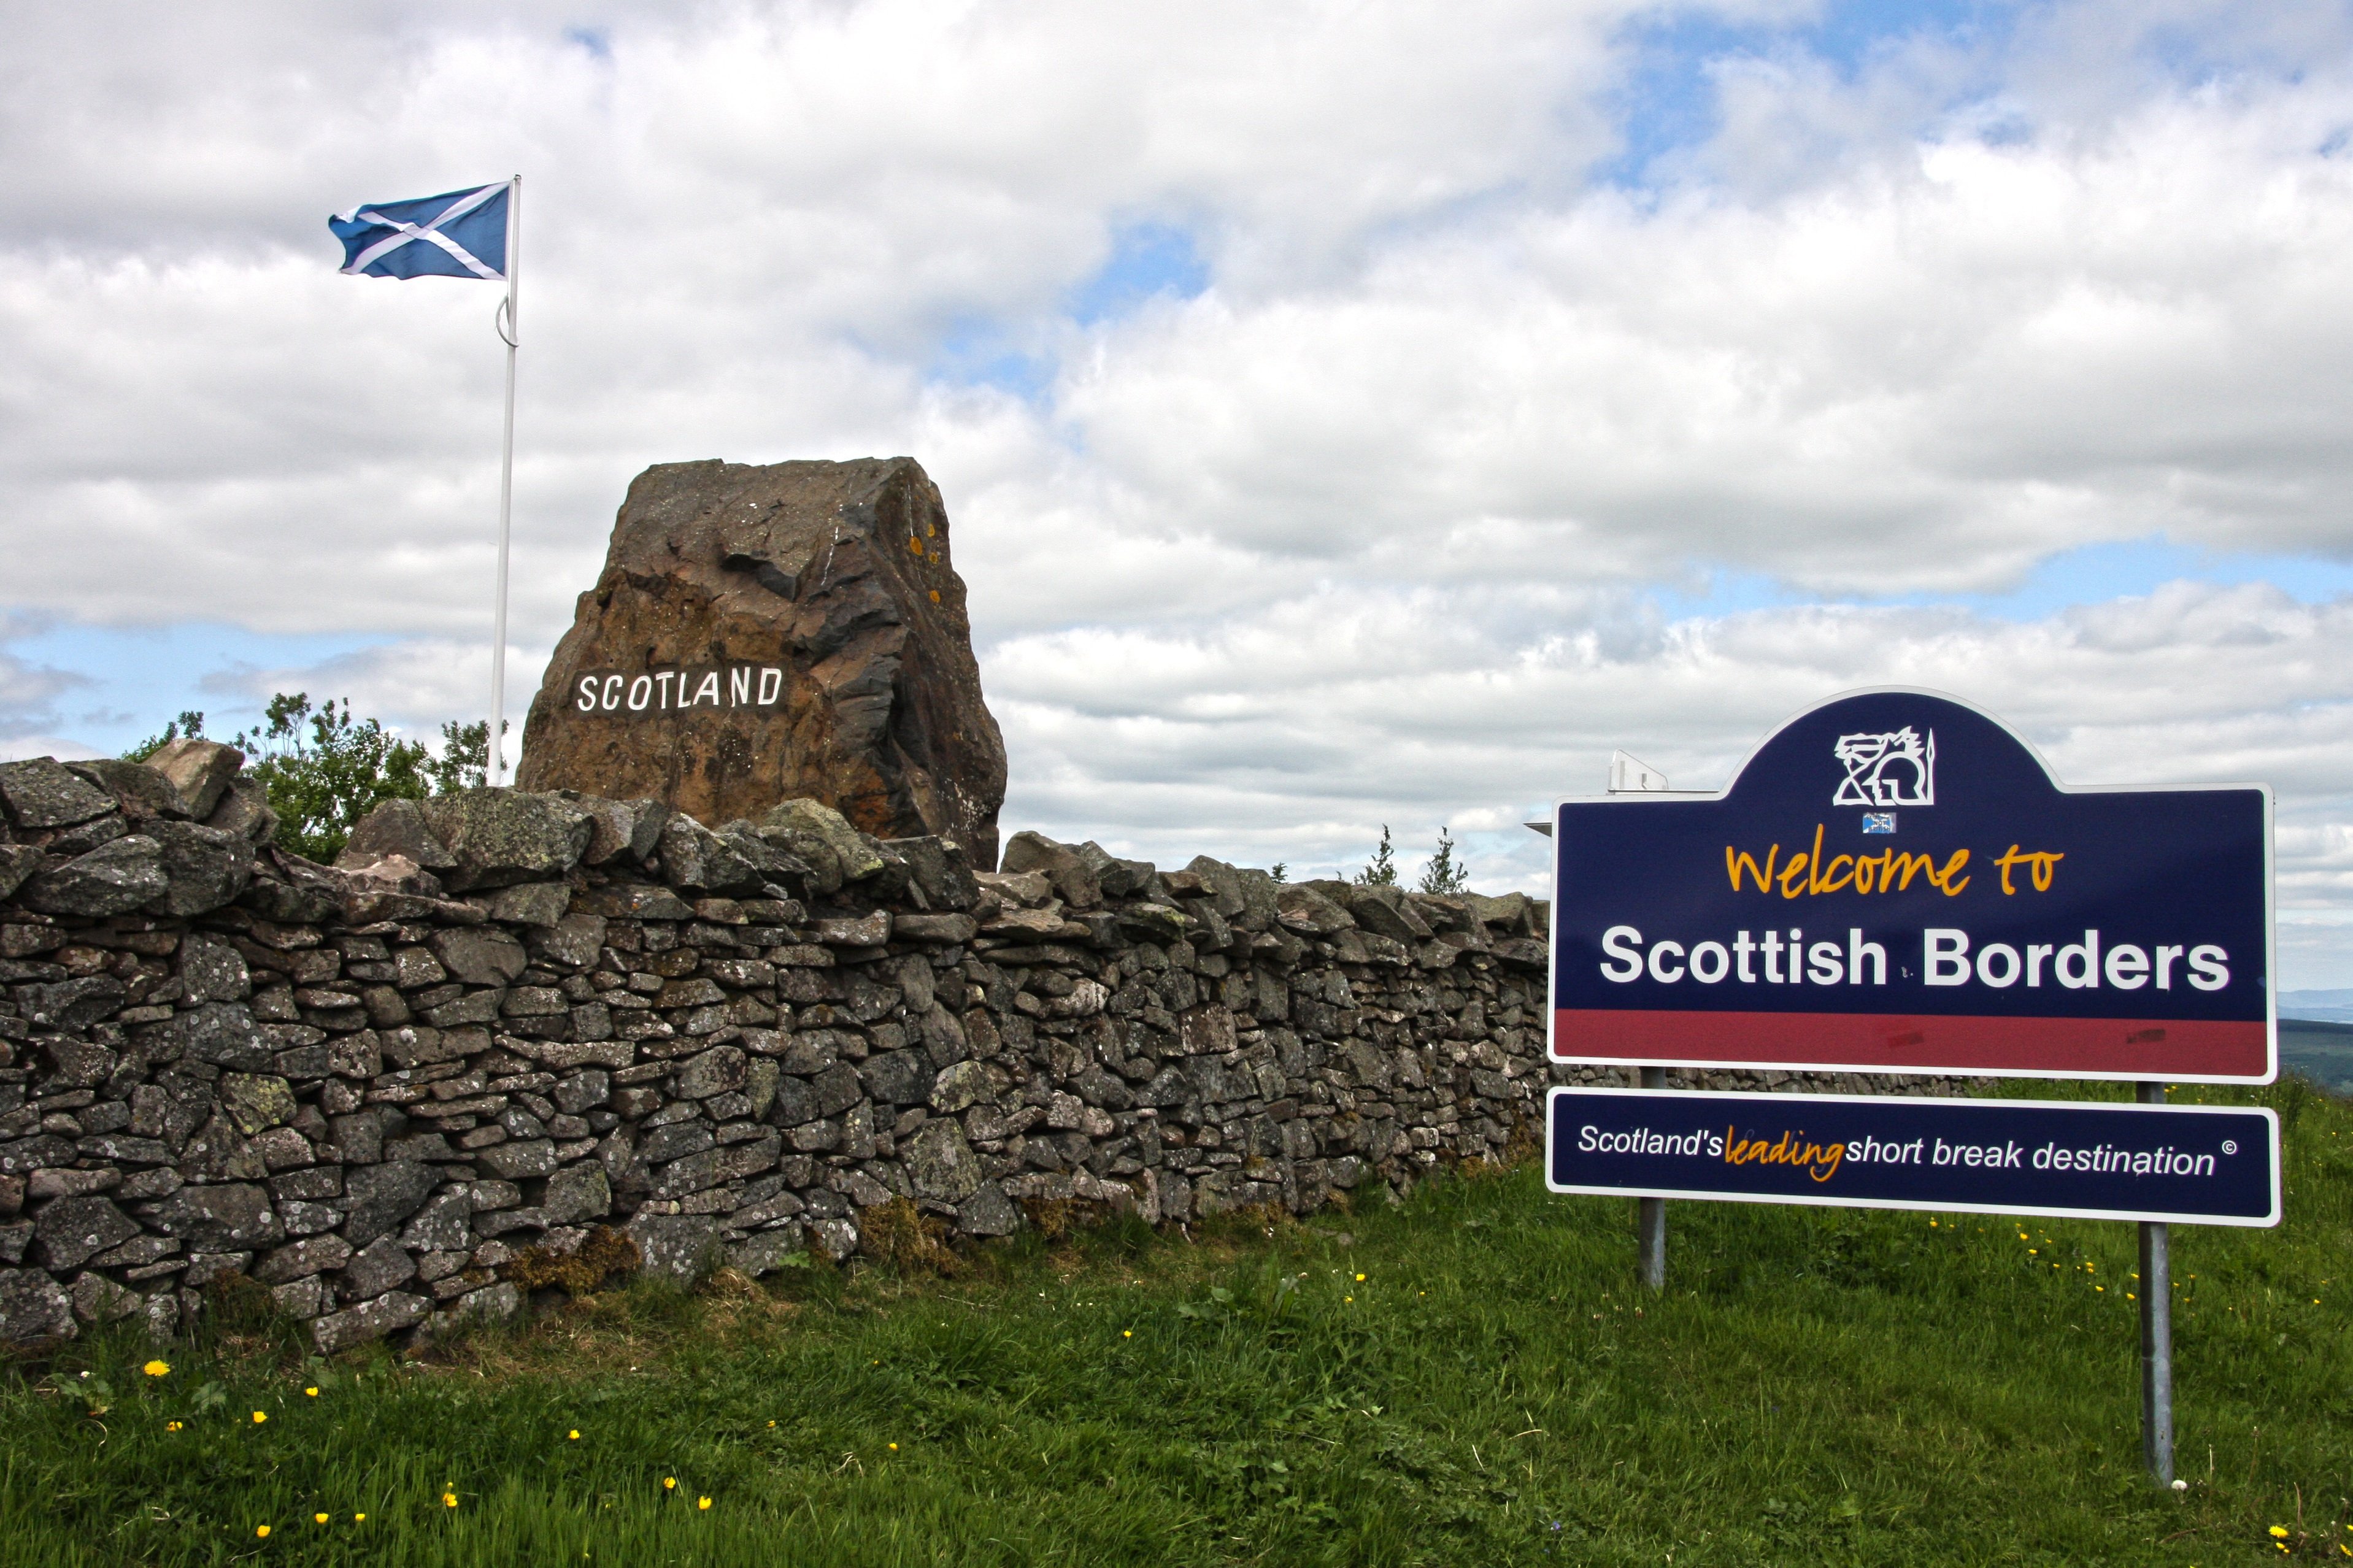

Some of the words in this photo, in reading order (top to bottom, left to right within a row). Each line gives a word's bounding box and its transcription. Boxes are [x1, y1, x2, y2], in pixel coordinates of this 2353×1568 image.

[577, 666, 782, 712] SCOTLAND
[1725, 823, 1971, 899] Welcome
[1994, 844, 2065, 896] to
[1600, 925, 1887, 985] Scottish
[1924, 928, 2230, 991] Borders
[1577, 1125, 1723, 1156] Scotland's
[1725, 1125, 1845, 1182] leading
[1845, 1136, 1924, 1164] short
[1932, 1138, 2024, 1168] break
[2033, 1142, 2215, 1176] destination
